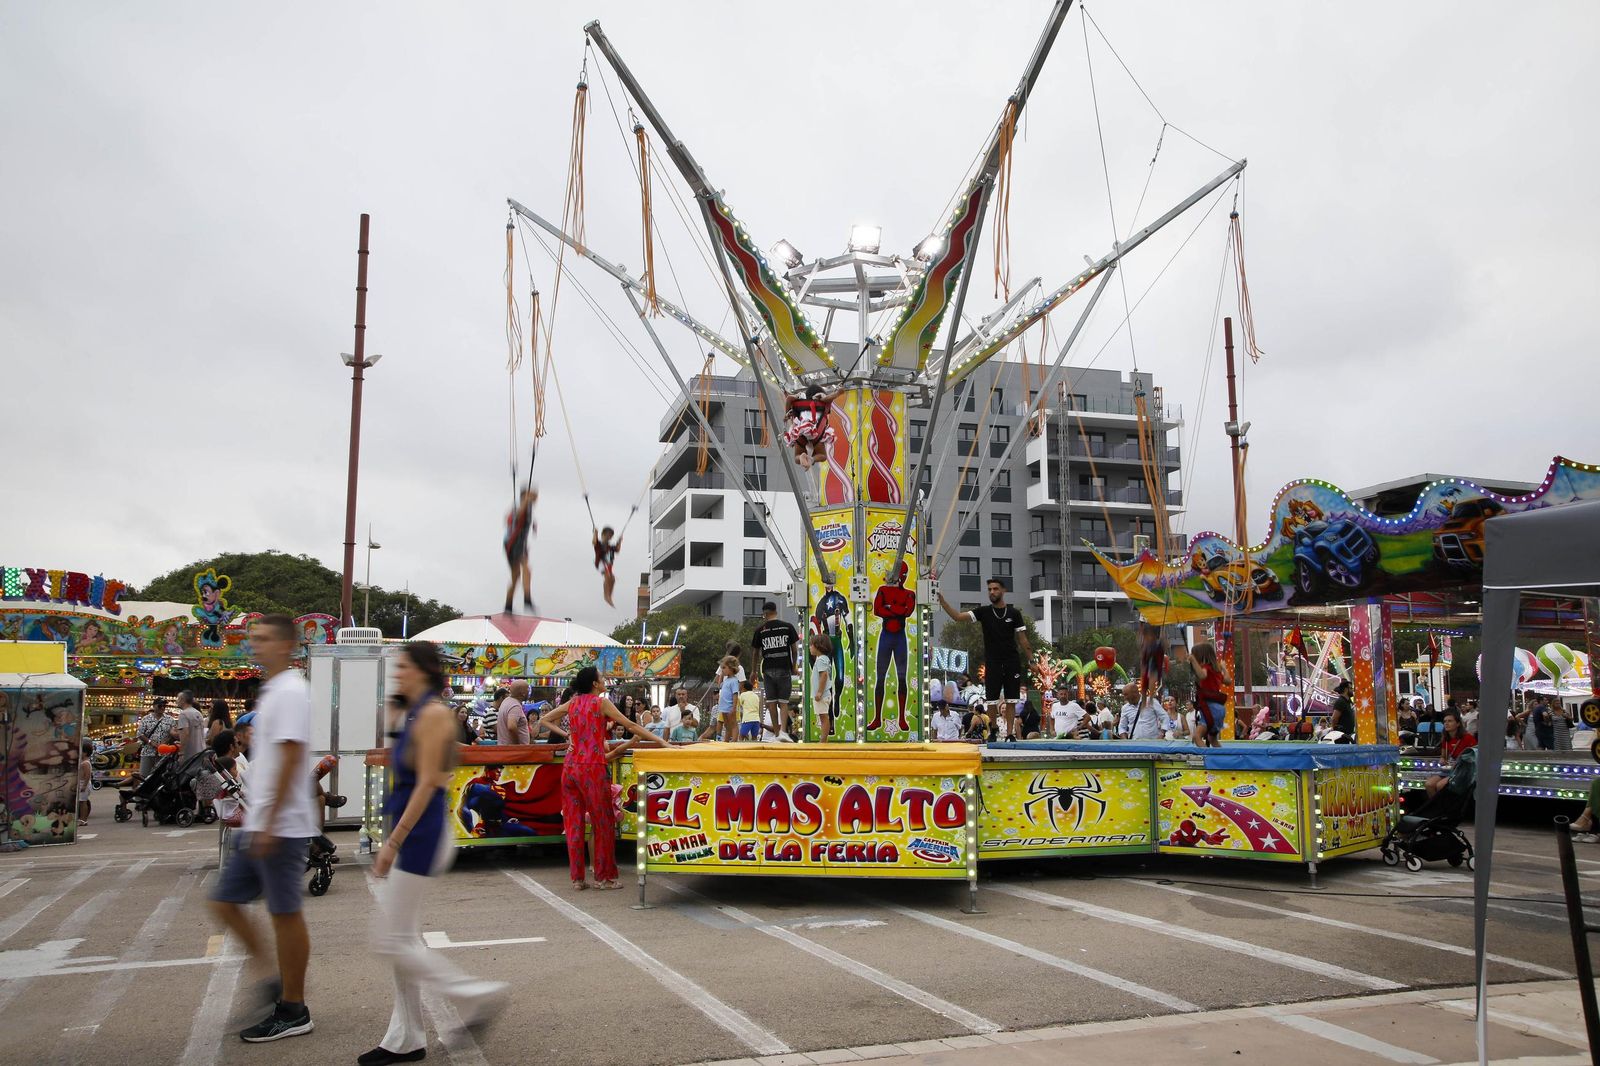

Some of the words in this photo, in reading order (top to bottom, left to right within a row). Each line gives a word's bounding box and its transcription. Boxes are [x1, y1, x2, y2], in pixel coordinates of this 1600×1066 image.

[0, 567, 126, 616] EXTRIC
[647, 788, 701, 829] EL
[715, 783, 823, 836] MAS
[838, 784, 966, 834] ALTO
[647, 839, 679, 857] IRON
[679, 833, 707, 851] MAN
[719, 840, 757, 861] DE
[765, 840, 802, 861] LA
[810, 841, 899, 862] FERIA
[907, 838, 960, 859] AMERICA
[924, 838, 949, 846] CAPTAIN
